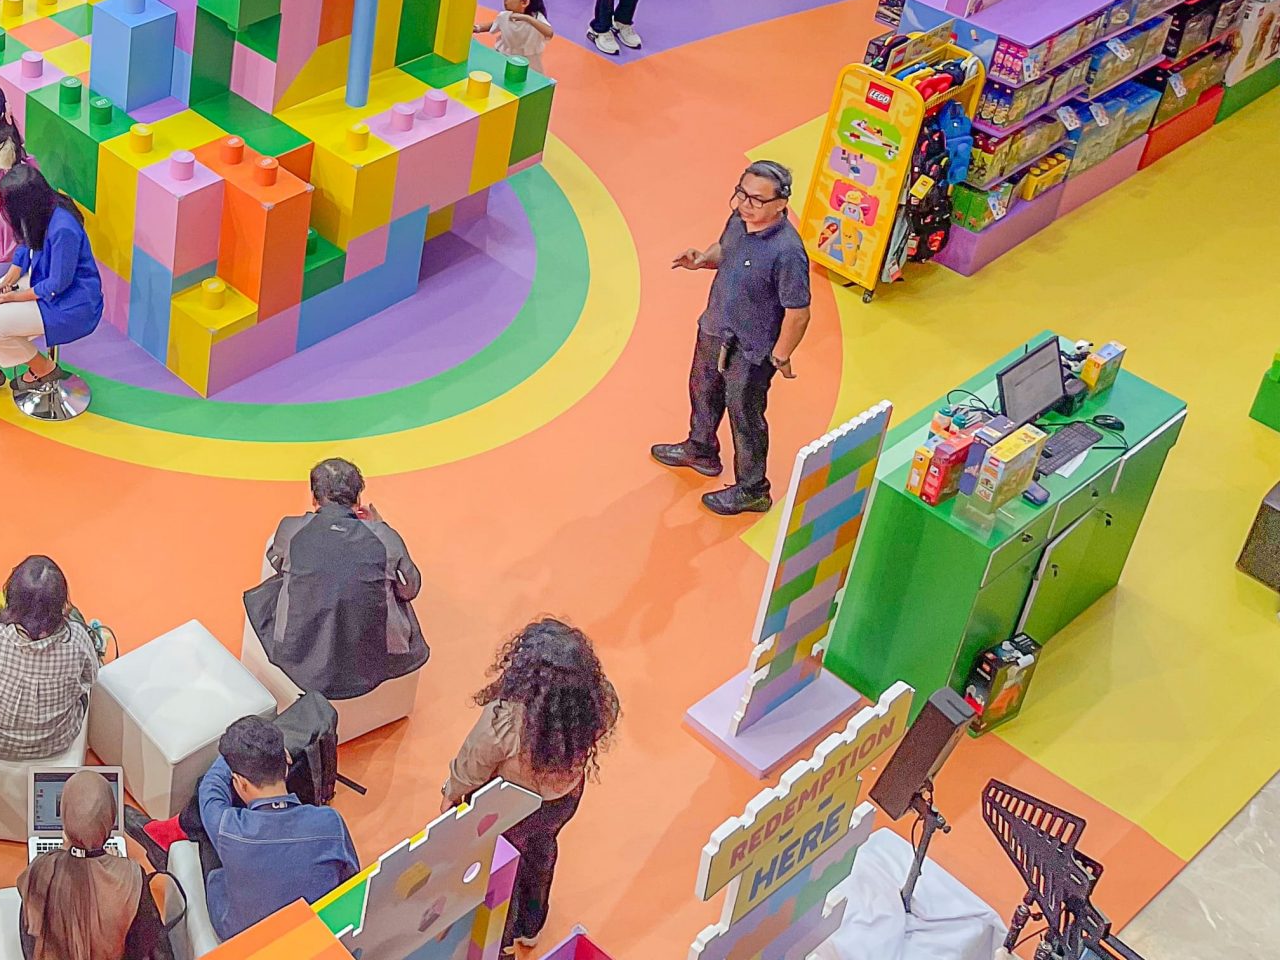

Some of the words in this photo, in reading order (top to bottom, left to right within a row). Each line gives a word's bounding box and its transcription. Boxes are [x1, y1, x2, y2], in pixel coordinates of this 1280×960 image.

[868, 89, 891, 105] LEGO
[728, 716, 897, 870] REDEMPTION
[748, 802, 846, 903] HERE
